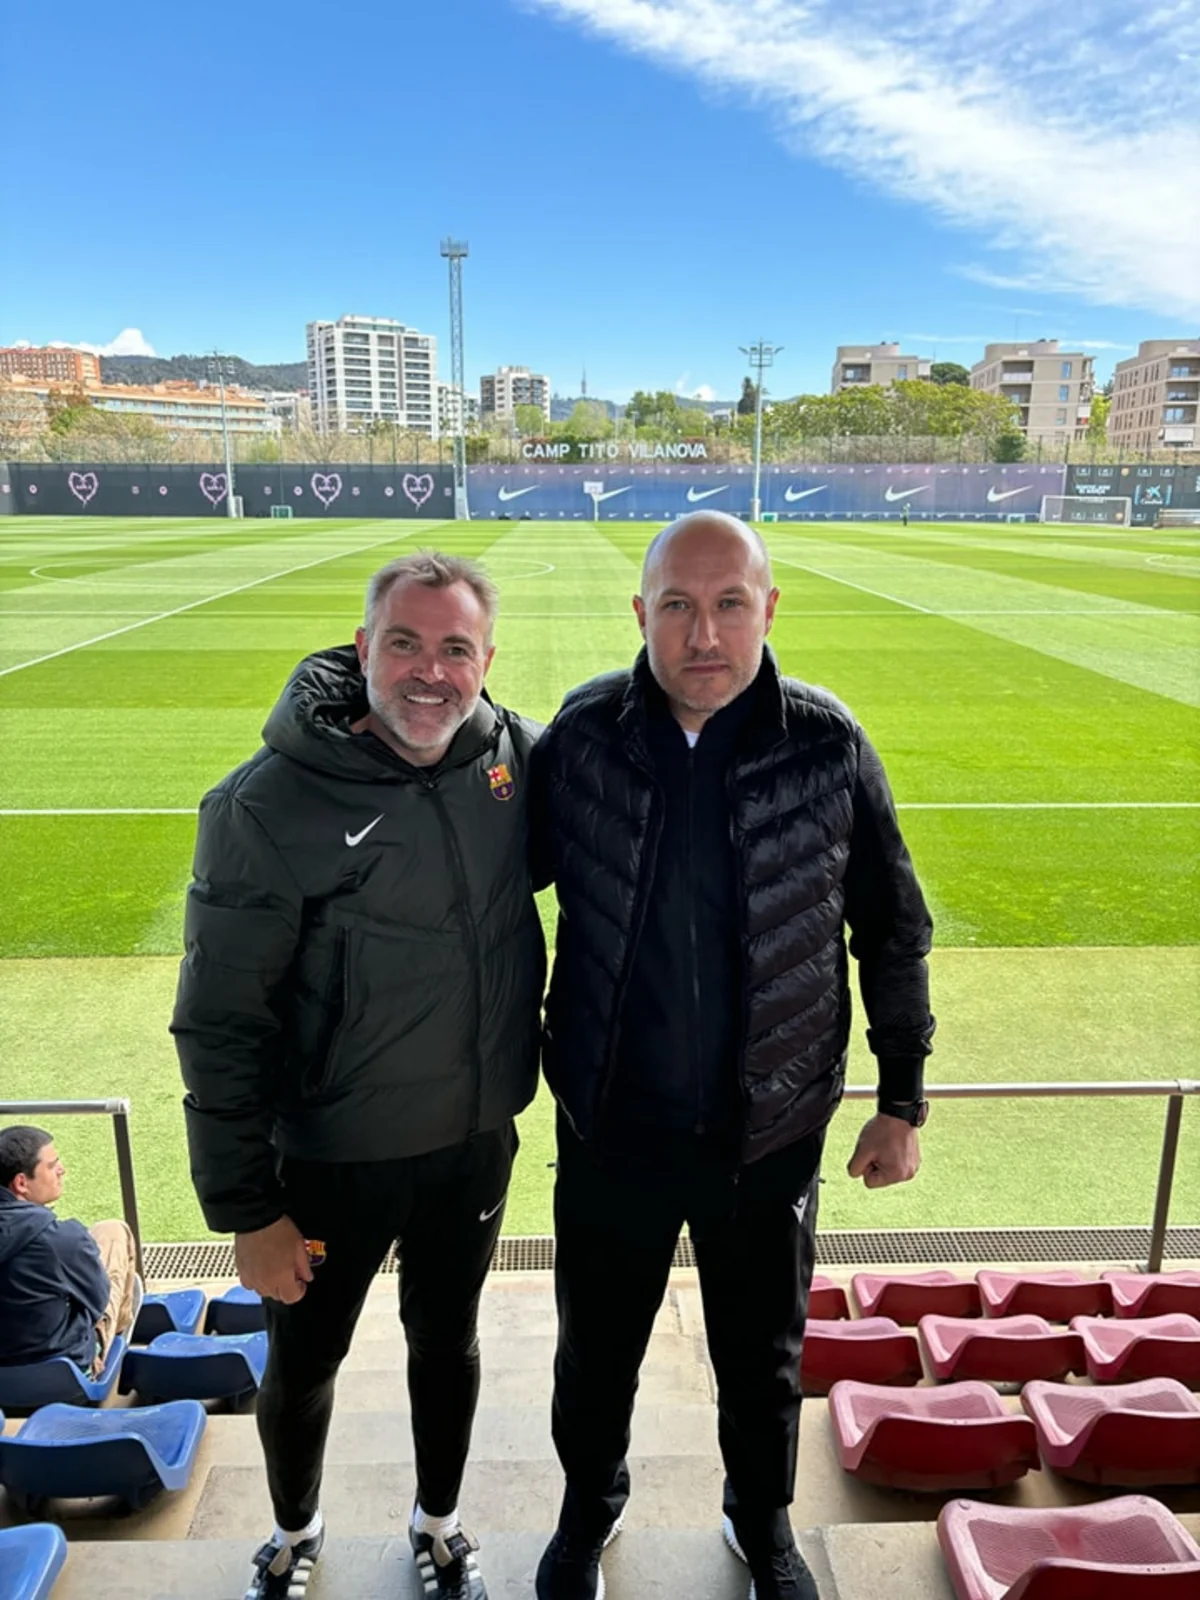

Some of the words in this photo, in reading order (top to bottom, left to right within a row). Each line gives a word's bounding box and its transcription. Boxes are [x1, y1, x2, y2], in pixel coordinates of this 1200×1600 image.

[522, 443, 570, 458] CAMP
[578, 443, 620, 458] TITO
[628, 443, 707, 458] VILANOVA
